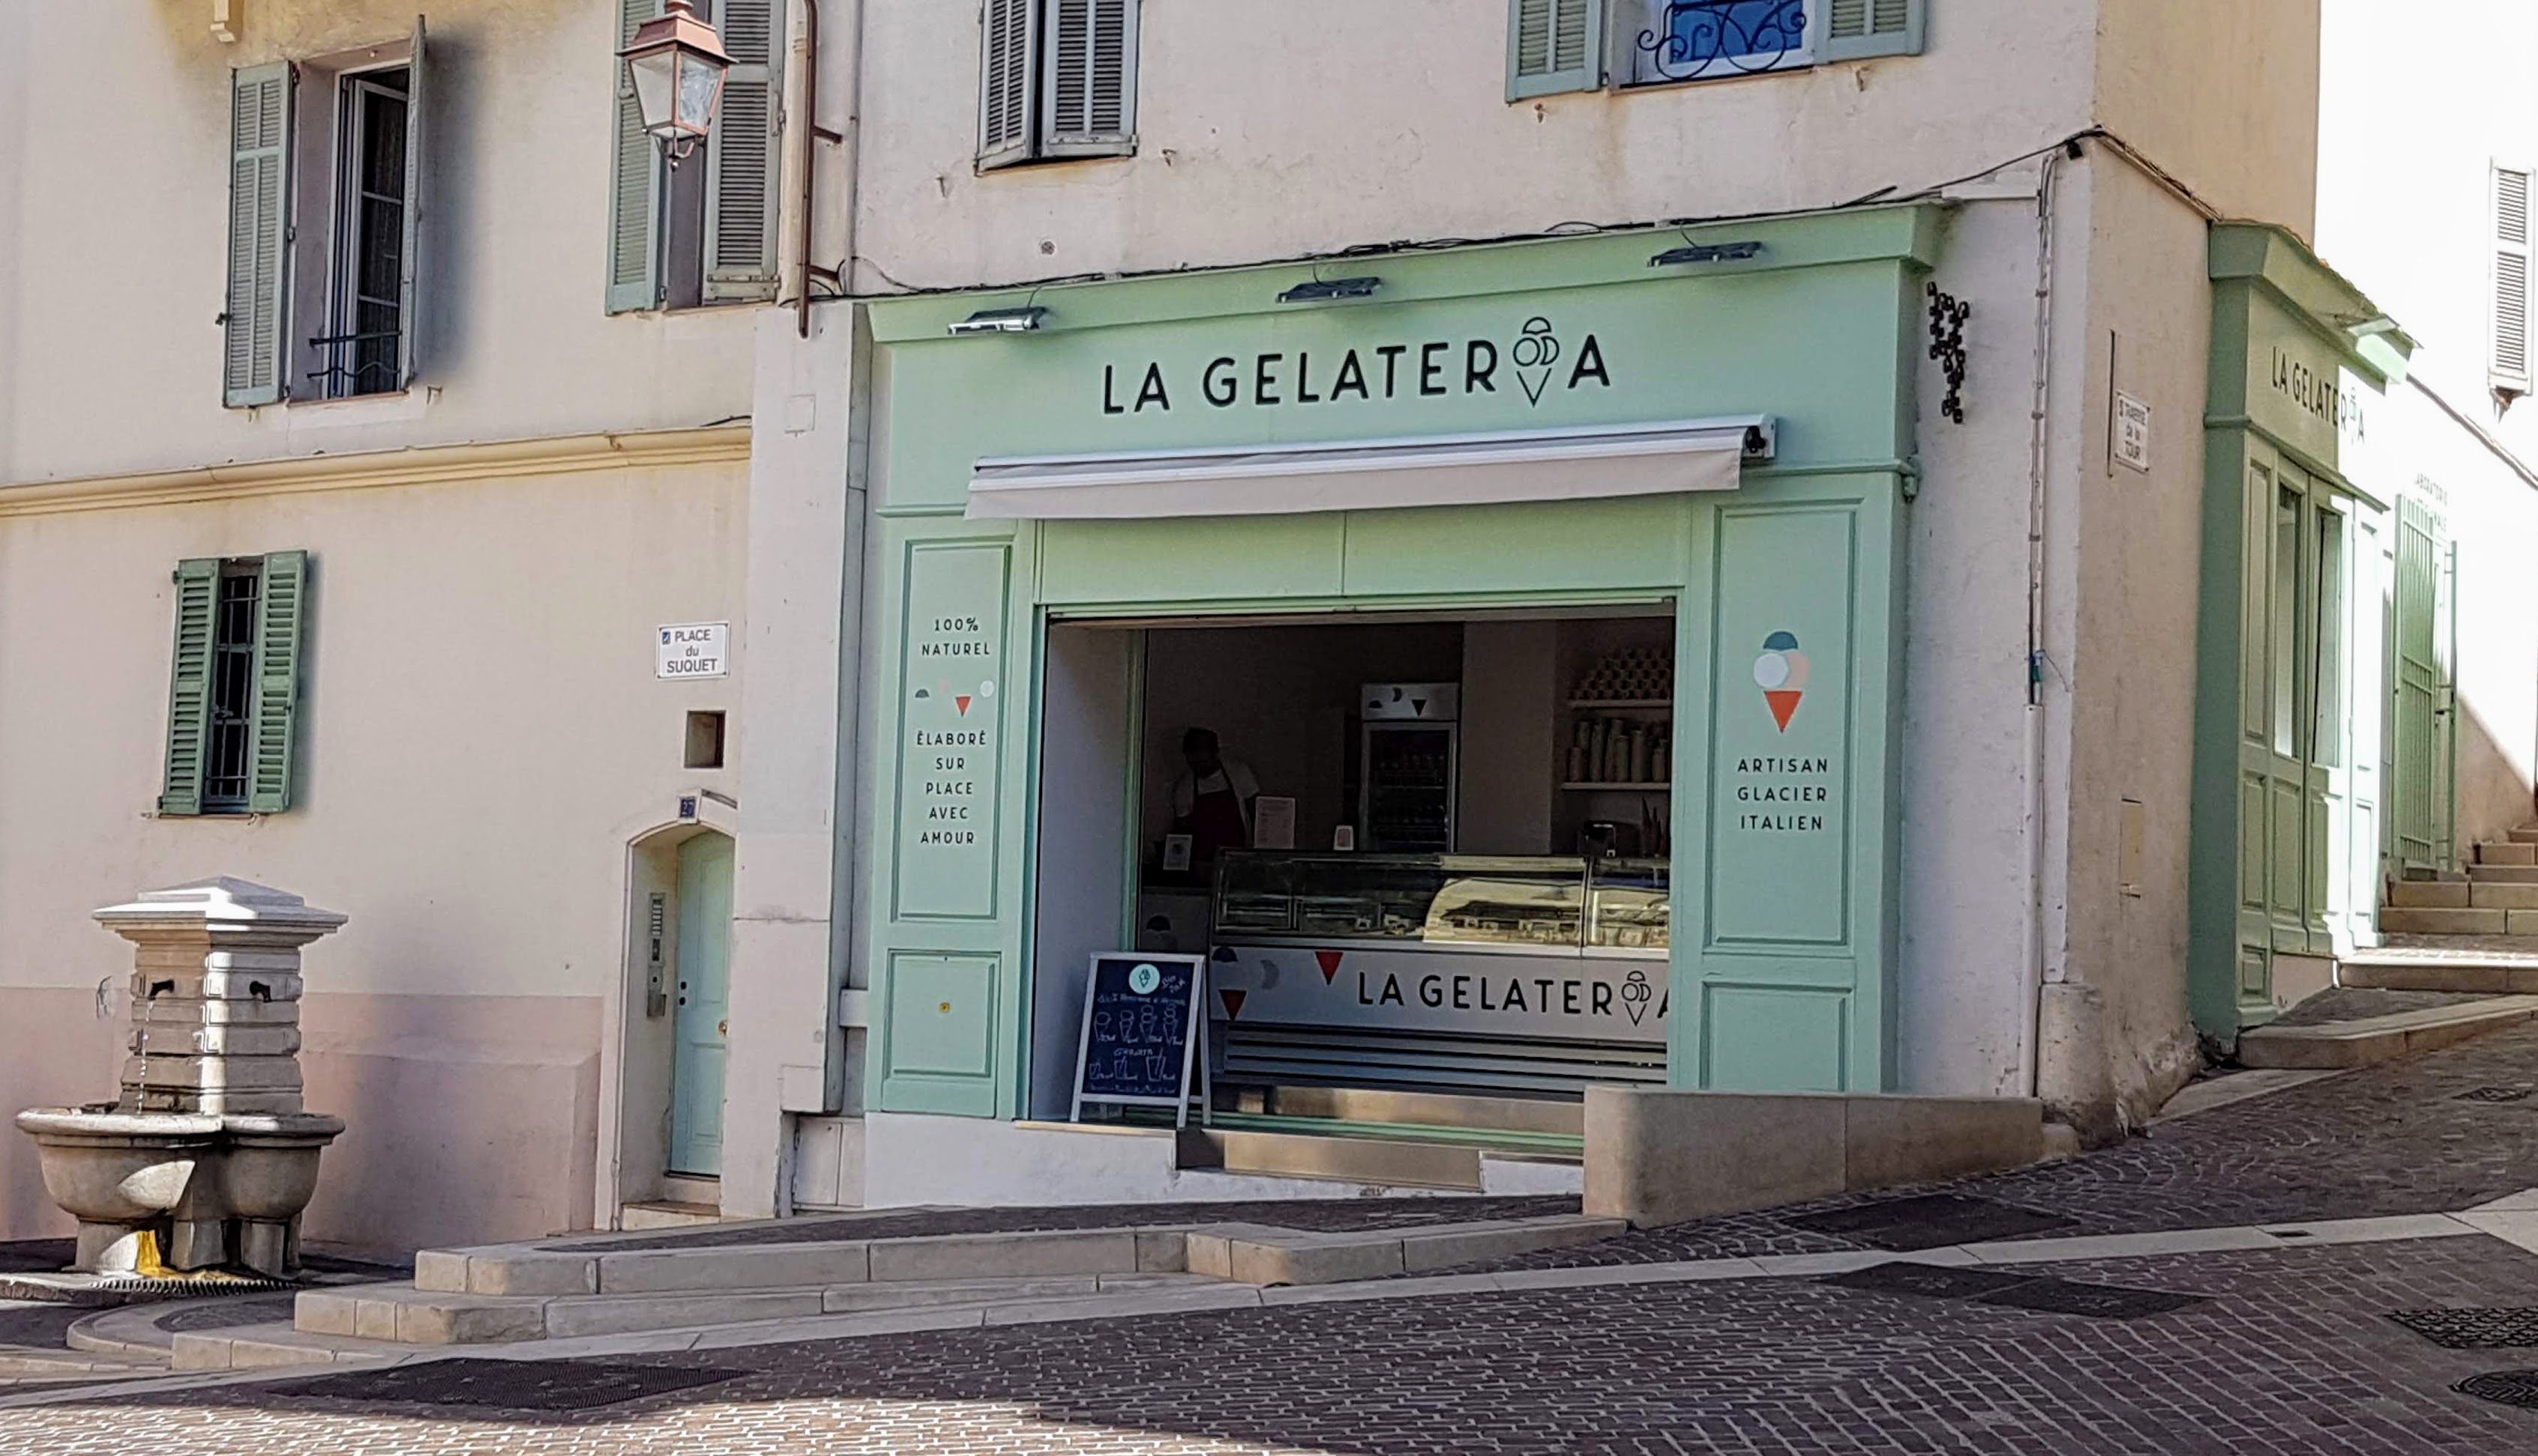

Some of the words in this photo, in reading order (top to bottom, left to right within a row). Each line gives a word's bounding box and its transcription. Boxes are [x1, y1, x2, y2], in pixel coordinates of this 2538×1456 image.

[2272, 346, 2288, 395] LA
[1104, 363, 1169, 413] LA
[936, 618, 978, 631] 100%
[676, 630, 710, 641] PLACE
[686, 646, 699, 656] du
[922, 643, 989, 655] NATUREL
[667, 659, 717, 673] SUQUET
[918, 730, 985, 744] ÉLABORÉ
[936, 758, 964, 769] SUR
[1738, 759, 1826, 772] ARTISAN
[927, 783, 972, 794] PLACE
[1738, 787, 1826, 801] GLACIER
[930, 807, 966, 819] AVEC
[1742, 816, 1821, 830] ITALIEN
[921, 832, 973, 843] AMOUR
[1360, 972, 1404, 1006] LA
